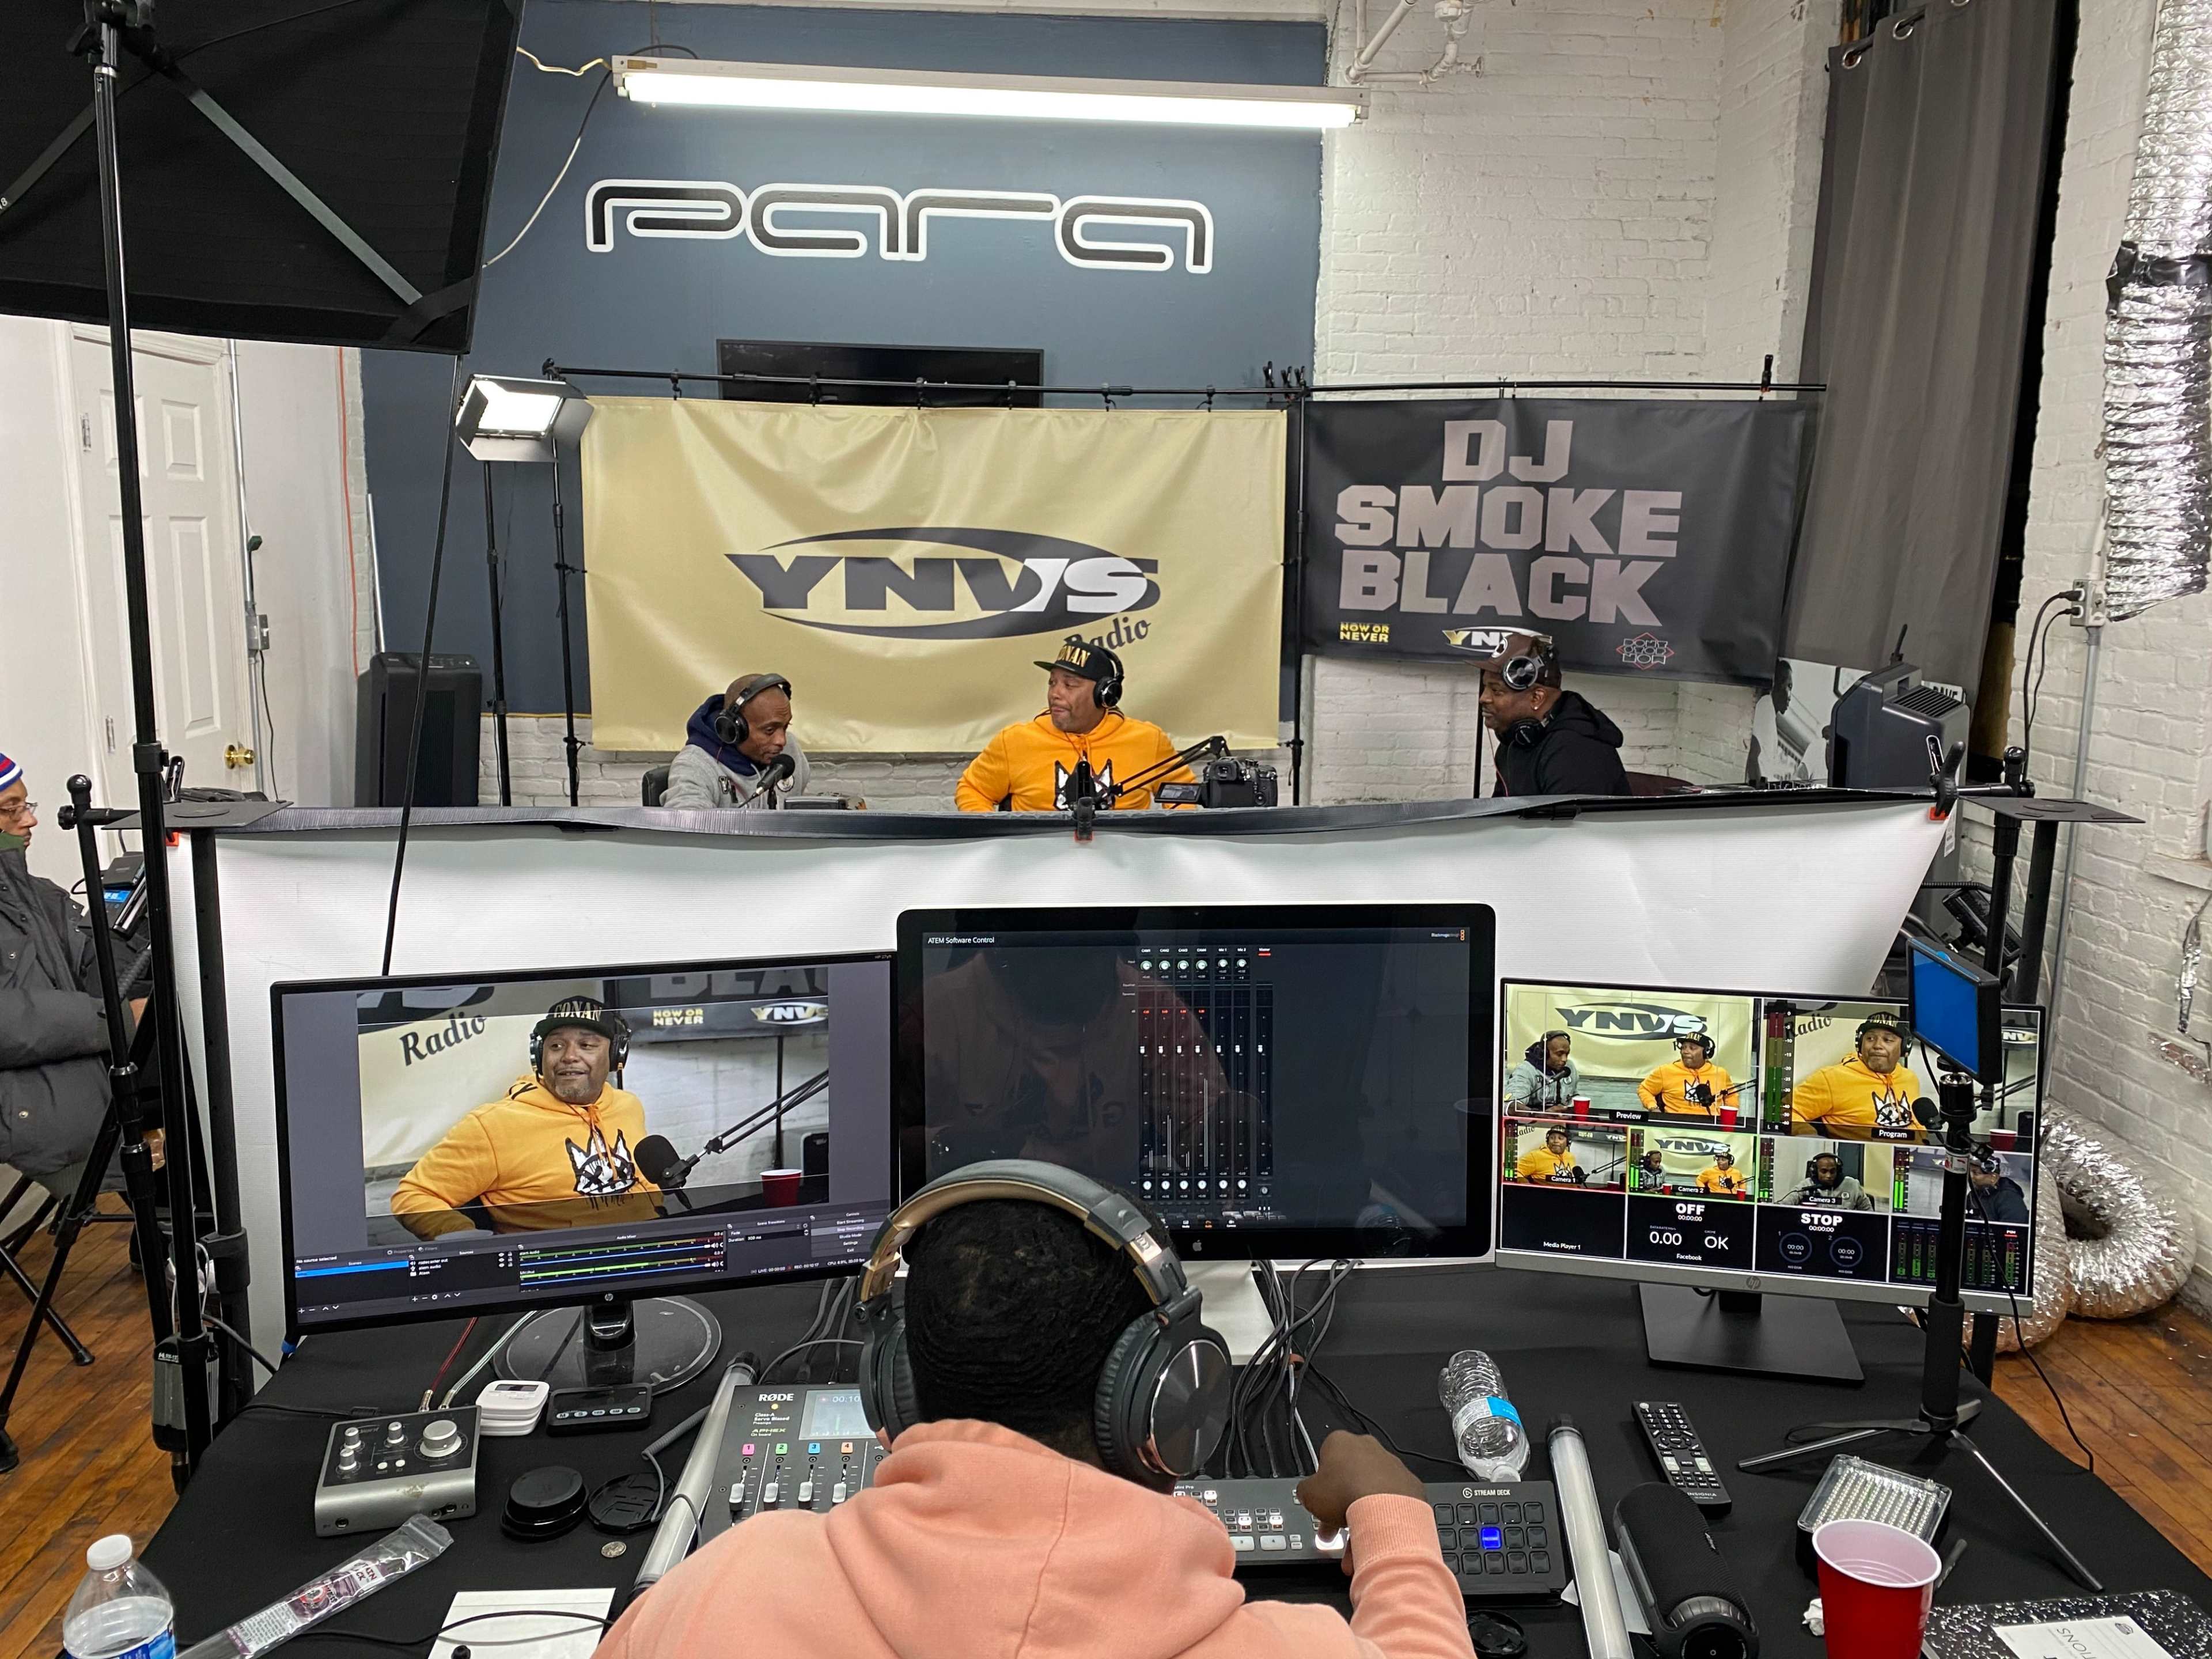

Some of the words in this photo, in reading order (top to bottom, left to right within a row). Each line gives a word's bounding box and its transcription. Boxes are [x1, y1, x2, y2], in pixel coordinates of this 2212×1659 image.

[1442, 419, 1574, 483] DJ
[1334, 484, 1682, 558] SMOKE
[724, 552, 1161, 614] YNVS
[1338, 549, 1664, 627] BLACK
[1340, 623, 1372, 632] NOW
[1372, 624, 1390, 632] OR
[1339, 631, 1389, 643] NEVER
[554, 999, 603, 1022] CONAN
[653, 1010, 683, 1018] NOW
[653, 1017, 703, 1026] NEVER
[1555, 1007, 1708, 1035] YNVS
[400, 1012, 487, 1066] Radio
[1616, 1112, 1642, 1120] Preview
[1879, 1130, 1907, 1138] Program
[1654, 1138, 1731, 1153] YNVS
[1675, 1203, 1705, 1215] OFF
[1801, 1213, 1843, 1226] STOP
[1649, 1231, 1682, 1245] 0.00
[1704, 1236, 1729, 1250] OK
[1676, 1253, 1702, 1261] Facebook
[758, 1393, 795, 1402] RØDE
